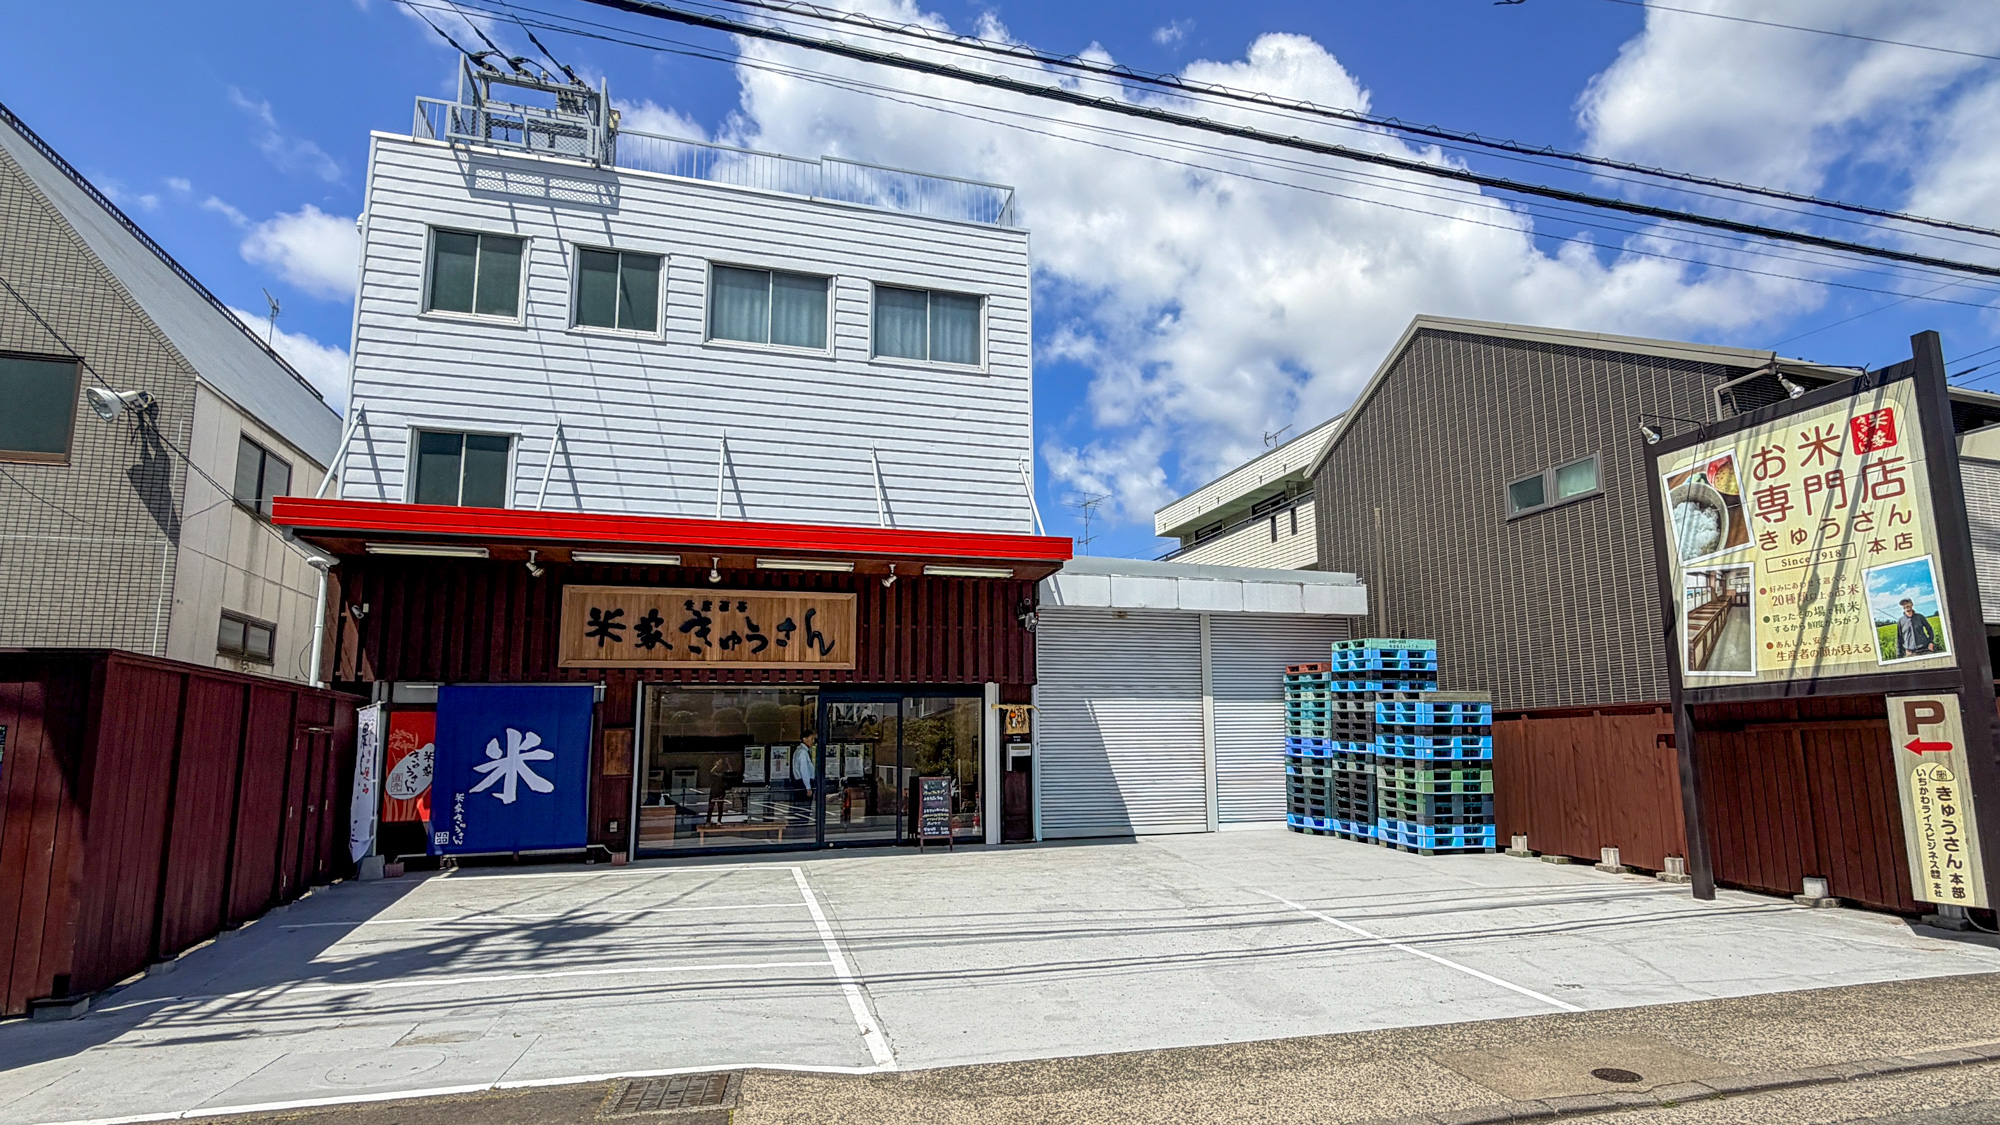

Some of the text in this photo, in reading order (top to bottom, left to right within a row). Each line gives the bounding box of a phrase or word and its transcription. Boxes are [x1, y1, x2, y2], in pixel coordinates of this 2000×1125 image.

[1751, 423, 1842, 481] お米
[1752, 456, 1906, 524] 専門店
[1759, 503, 1912, 551] きゅうさん
[1867, 532, 1914, 555] 本店
[1781, 549, 1842, 568] Since 1918
[1769, 574, 1847, 594] 好みにあわせて選べる
[1772, 601, 1860, 624] 買ったその場で精米
[1776, 635, 1831, 649] あんしん、安全
[1776, 643, 1872, 662] 生産者の顔が見える
[1903, 700, 1945, 736] P
[469, 727, 555, 805] 米
